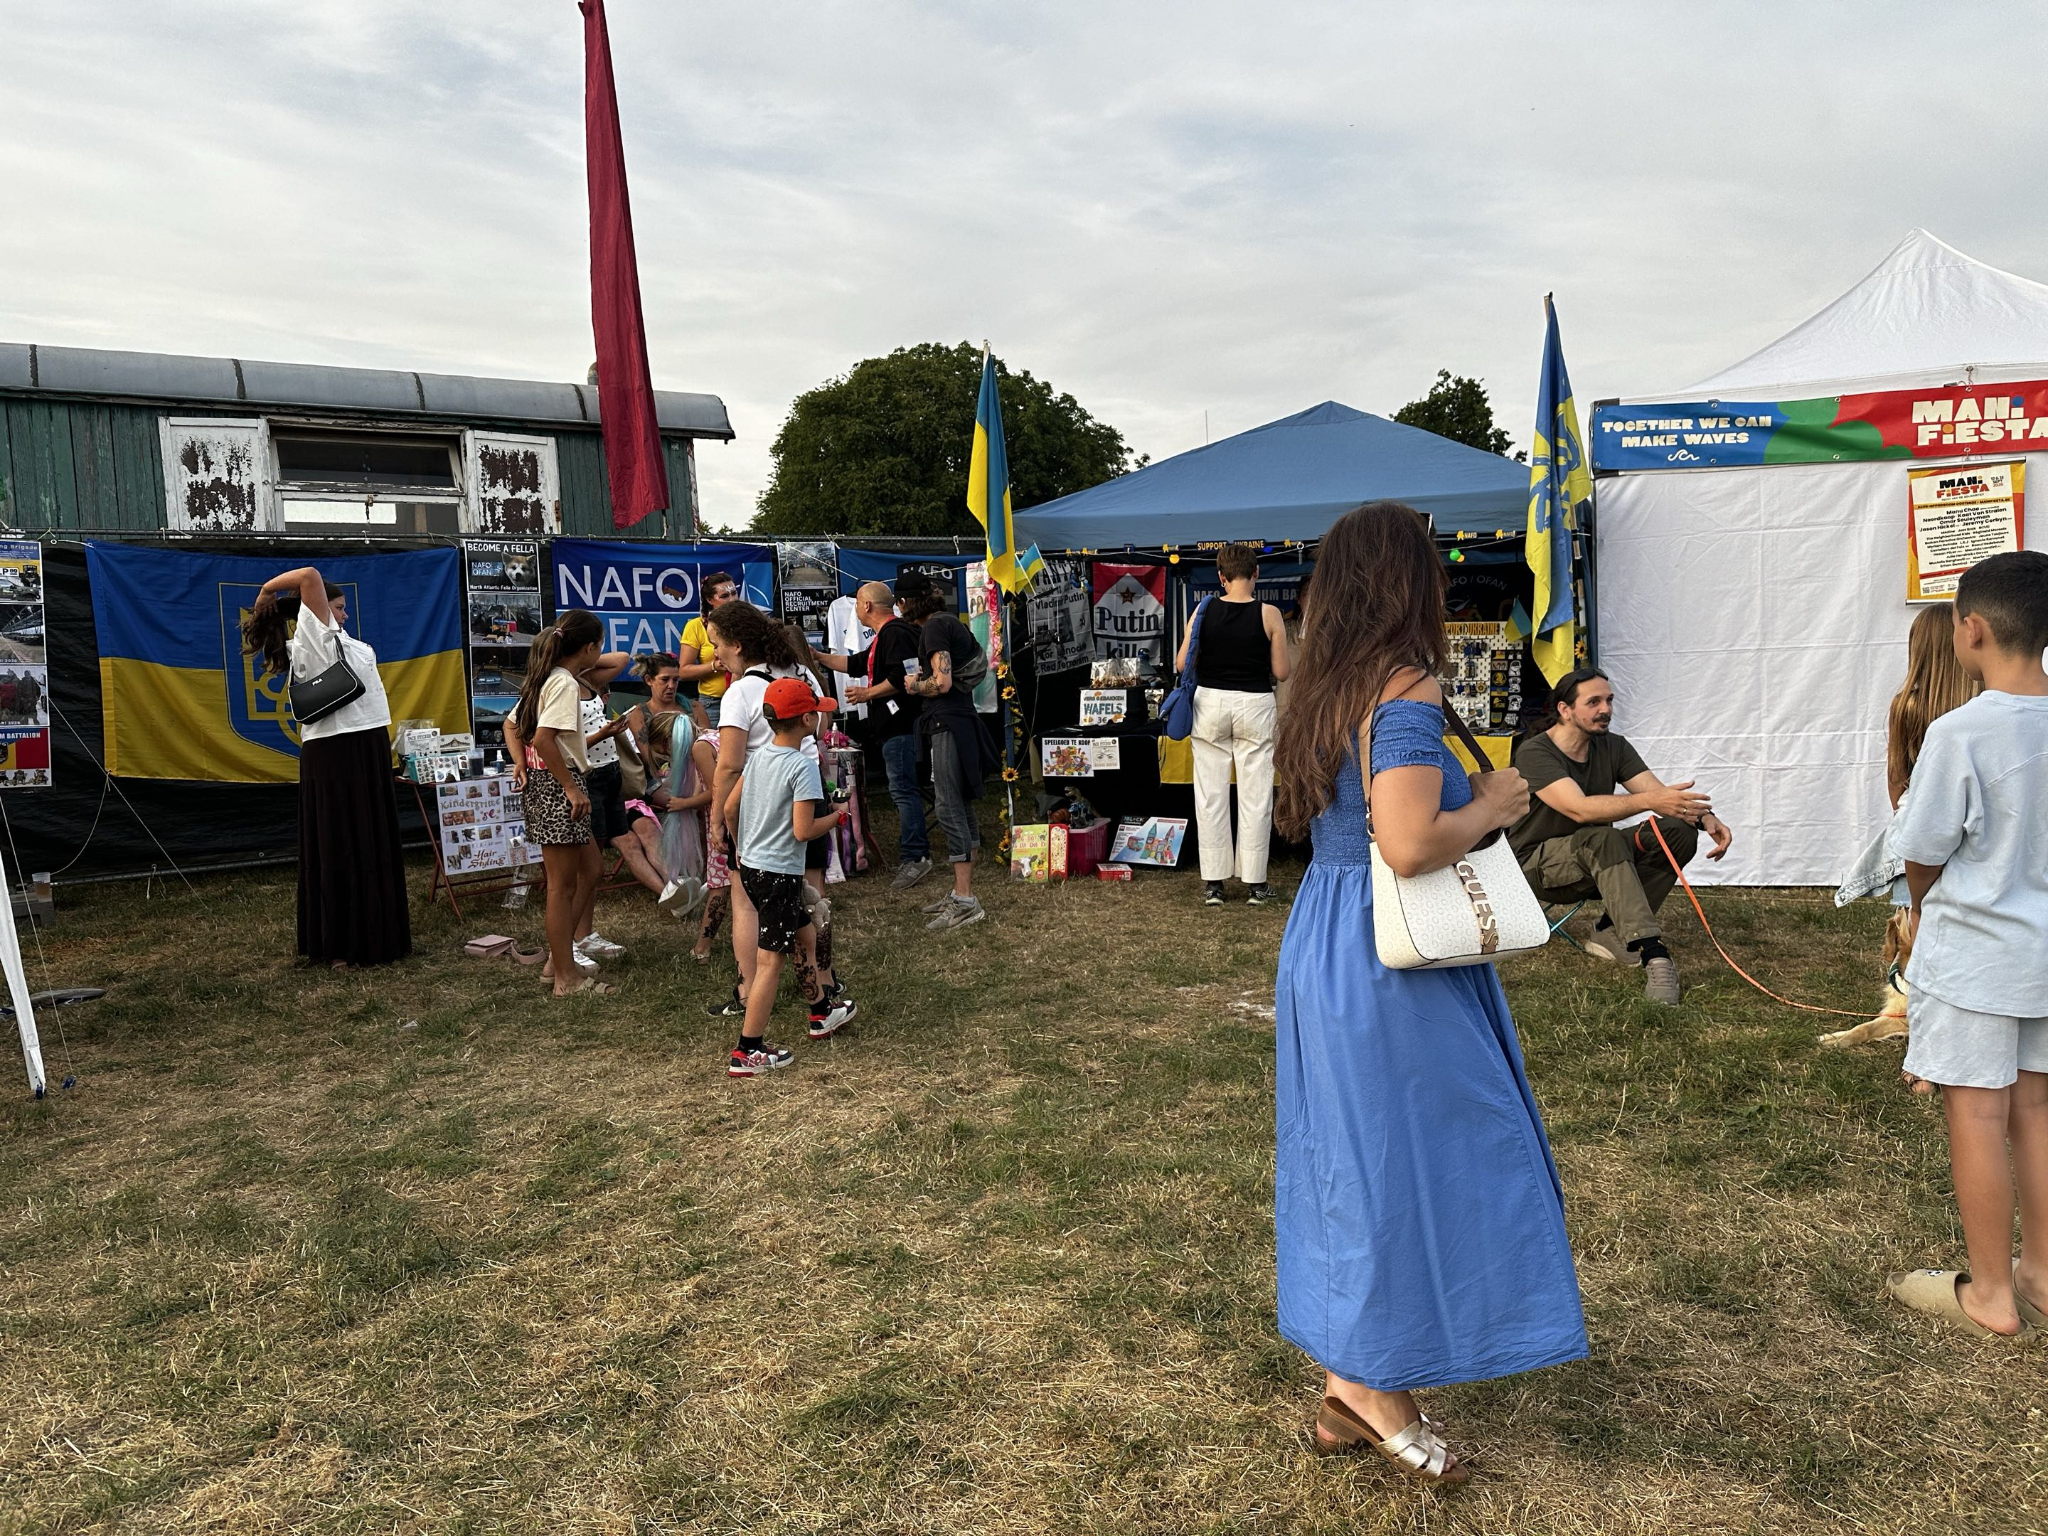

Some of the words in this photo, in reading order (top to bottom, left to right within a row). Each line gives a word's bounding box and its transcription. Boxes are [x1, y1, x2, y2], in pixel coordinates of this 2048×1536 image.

[1602, 419, 1693, 433] TOGETHER
[1699, 418, 1730, 430] WE
[1734, 416, 1772, 428] CAN
[1621, 434, 1677, 448] MAKE
[1683, 432, 1749, 445] WAVES
[467, 543, 501, 552] BECOME
[503, 544, 509, 552] A
[511, 544, 535, 553] FELLA
[1197, 541, 1227, 551] SUPPORT
[1234, 540, 1264, 549] UKRAINE
[903, 565, 953, 580] AFO
[558, 563, 694, 609] NAFO
[1064, 592, 1085, 605] Putin
[1194, 590, 1220, 602] NAFO
[1252, 588, 1281, 601] GIUM
[1095, 607, 1163, 633] Putin
[600, 618, 682, 659] FAN
[1041, 662, 1056, 673] Red
[1084, 703, 1123, 715] WAFELS
[473, 849, 498, 859] Hair
[467, 856, 506, 869] Styling
[1455, 860, 1499, 946] GUESS
